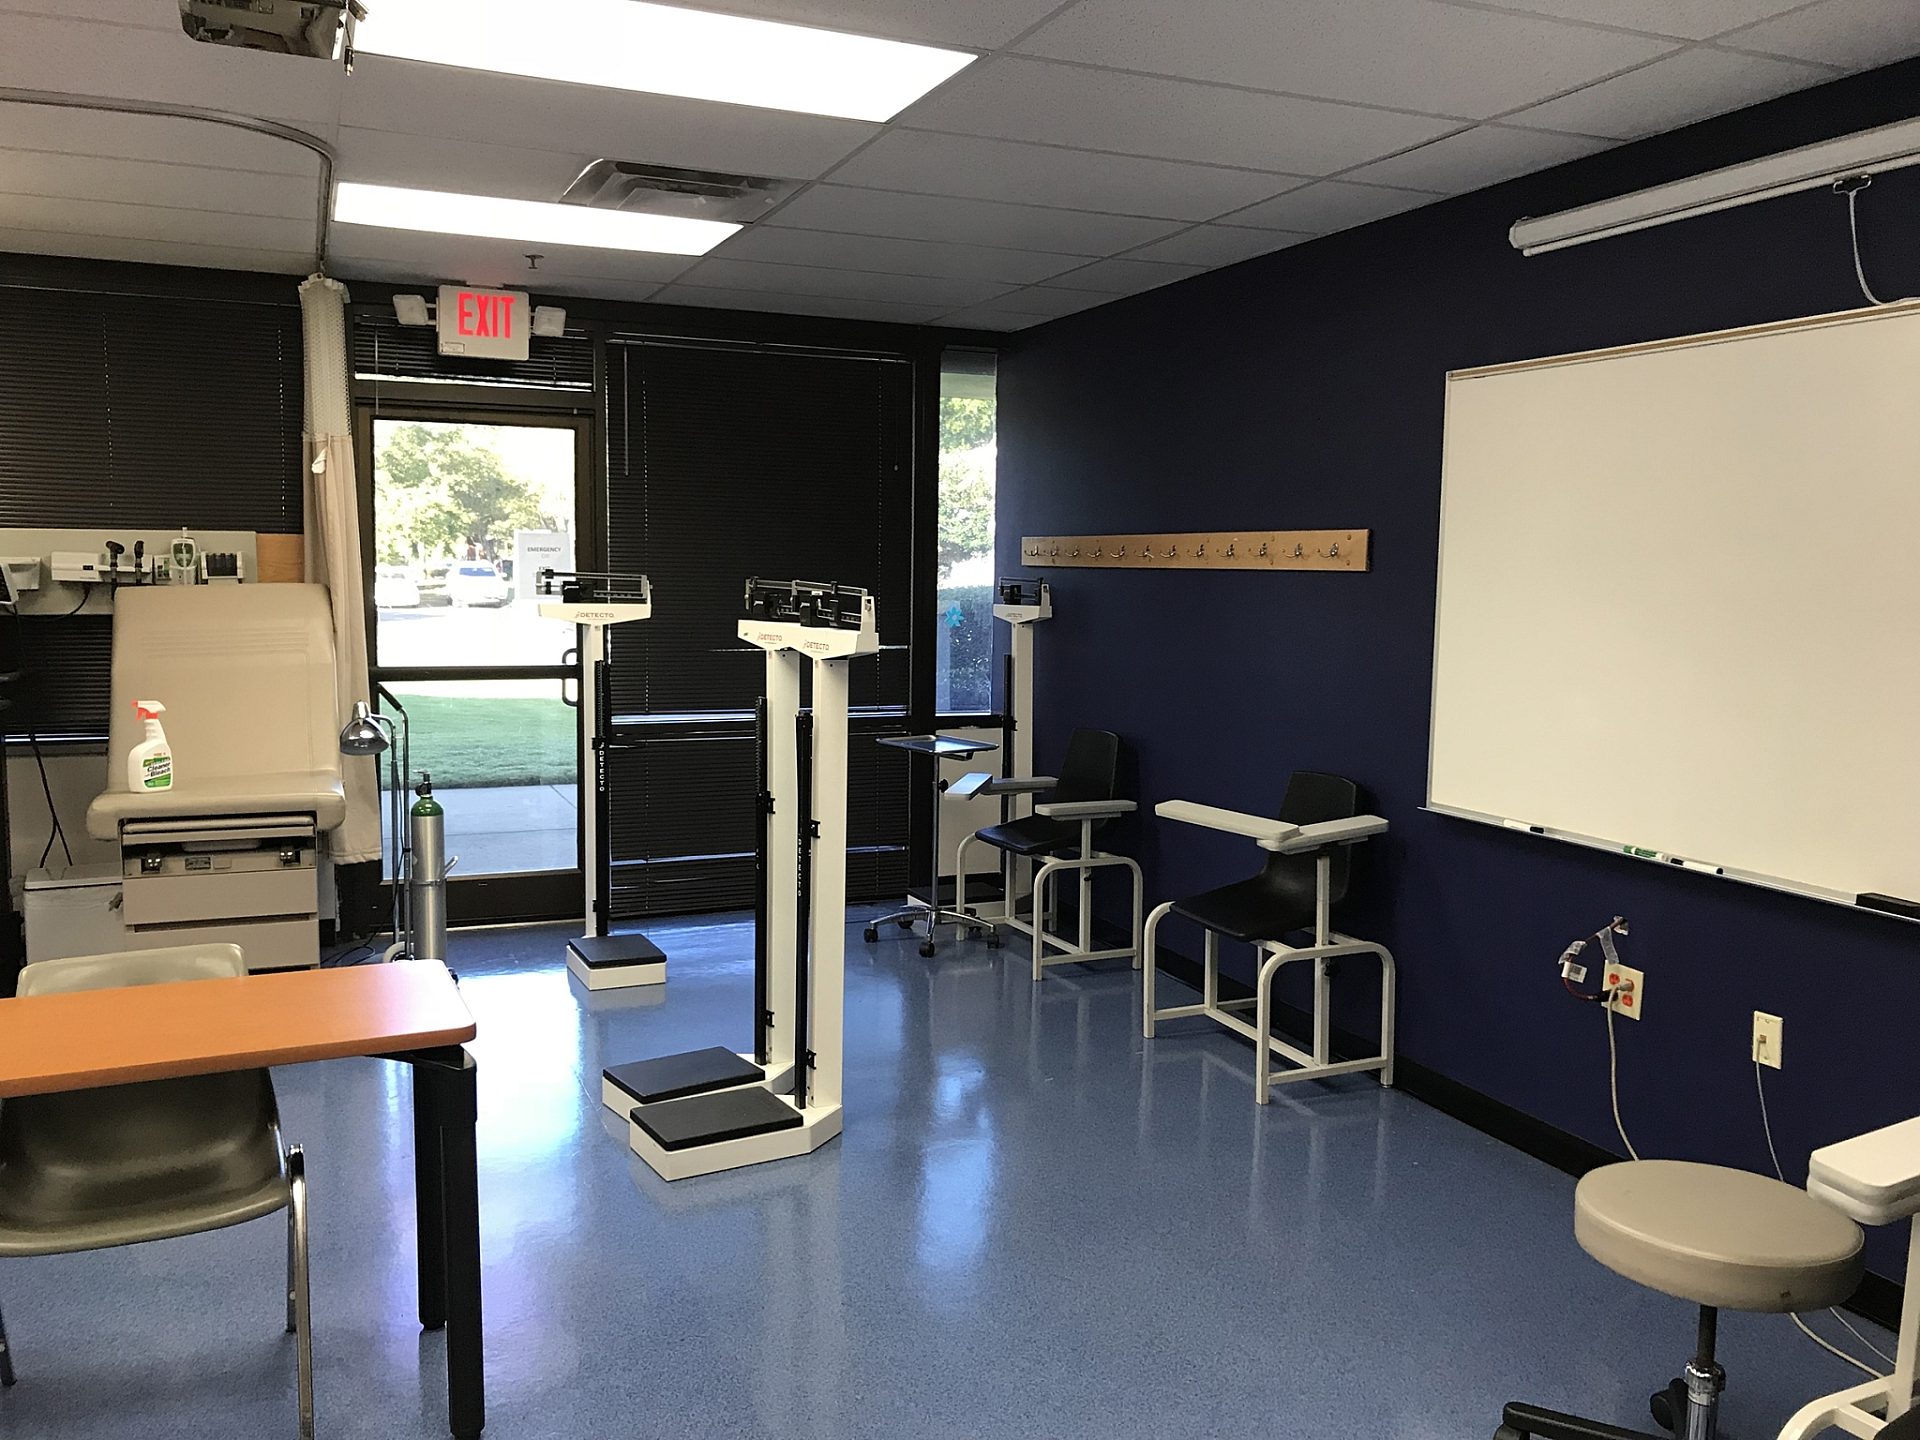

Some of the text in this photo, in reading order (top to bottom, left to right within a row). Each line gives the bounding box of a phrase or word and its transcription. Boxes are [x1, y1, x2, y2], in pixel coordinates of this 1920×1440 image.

[457, 291, 515, 339] EXIT
[807, 641, 829, 650] DETECTO
[147, 762, 170, 773] Cleaner
